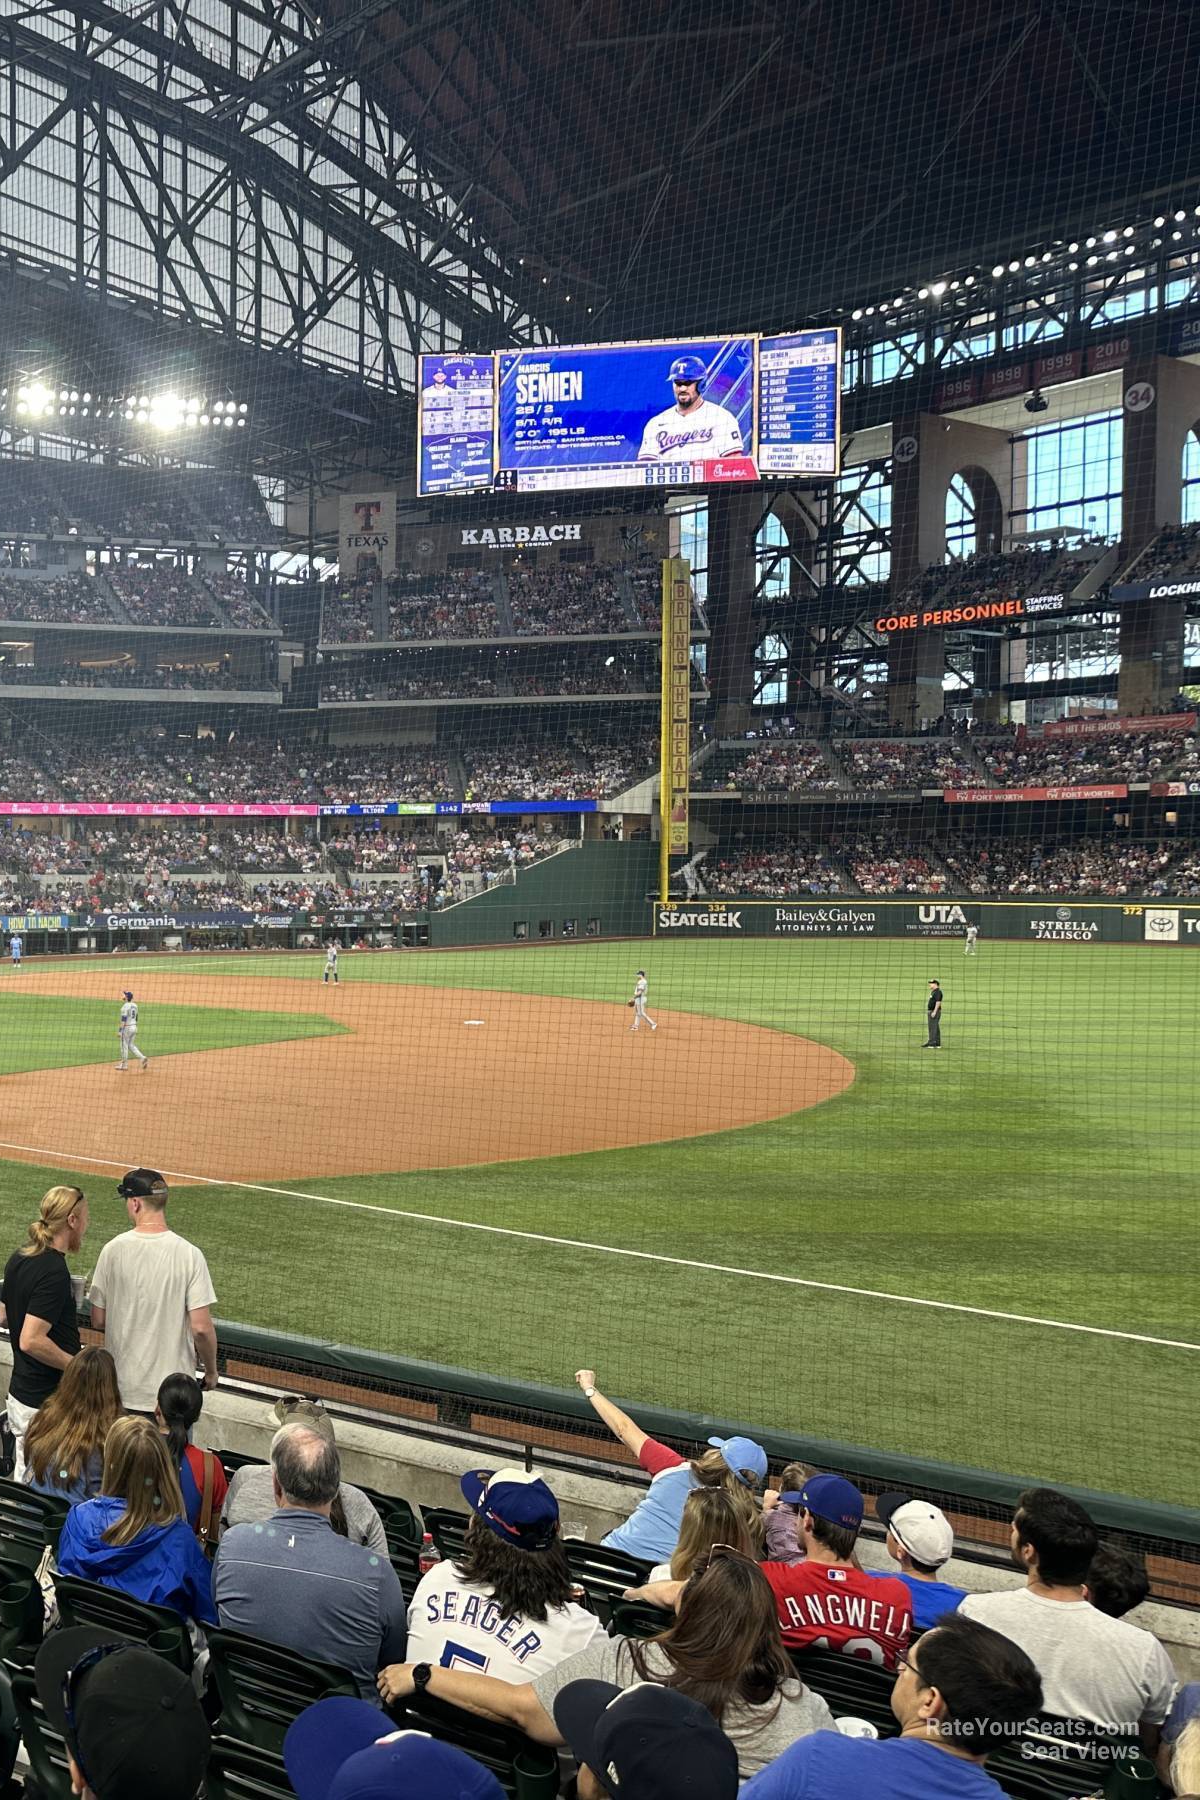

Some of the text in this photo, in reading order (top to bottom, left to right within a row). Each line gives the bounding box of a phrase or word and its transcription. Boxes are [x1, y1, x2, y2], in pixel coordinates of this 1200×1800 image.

[518, 363, 551, 374] MARCUS
[677, 363, 687, 374] T
[1041, 353, 1073, 371] 1999
[992, 367, 1022, 384] 1998
[516, 371, 583, 404] SEMIEN
[942, 382, 971, 396] 1996
[1128, 387, 1151, 406] 34
[515, 406, 535, 415] 2B
[542, 417, 562, 425] R/R
[548, 428, 568, 436] 195
[656, 425, 715, 450] Rangers
[355, 501, 381, 531] T
[461, 524, 582, 545] KARBACH
[346, 535, 389, 548] TEXAS
[1025, 593, 1064, 606] STAFFING
[1026, 601, 1063, 613] SERVICES
[876, 600, 1024, 632] CORE PERSONNEL
[676, 584, 685, 664] BRING
[675, 672, 684, 717] THE
[1065, 724, 1078, 733] HIT
[1081, 722, 1097, 732] THE
[675, 725, 685, 788] HEAT
[994, 793, 1023, 801] WORTH
[1084, 790, 1114, 798] WORTH
[708, 904, 726, 912] 334
[918, 905, 967, 923] UTA
[1123, 907, 1143, 915] 372
[8, 917, 26, 929] HOW
[38, 916, 62, 929] NACHO
[107, 914, 177, 928] Germania
[659, 911, 742, 929] SEATGEEK
[775, 908, 876, 924] Bailey&Galyen
[775, 924, 831, 932] ATTORNEYS
[853, 924, 874, 932] LAW
[1030, 920, 1098, 932] ESTRELLA
[1036, 930, 1092, 940] JALISCO
[427, 1591, 543, 1665] SEAGER
